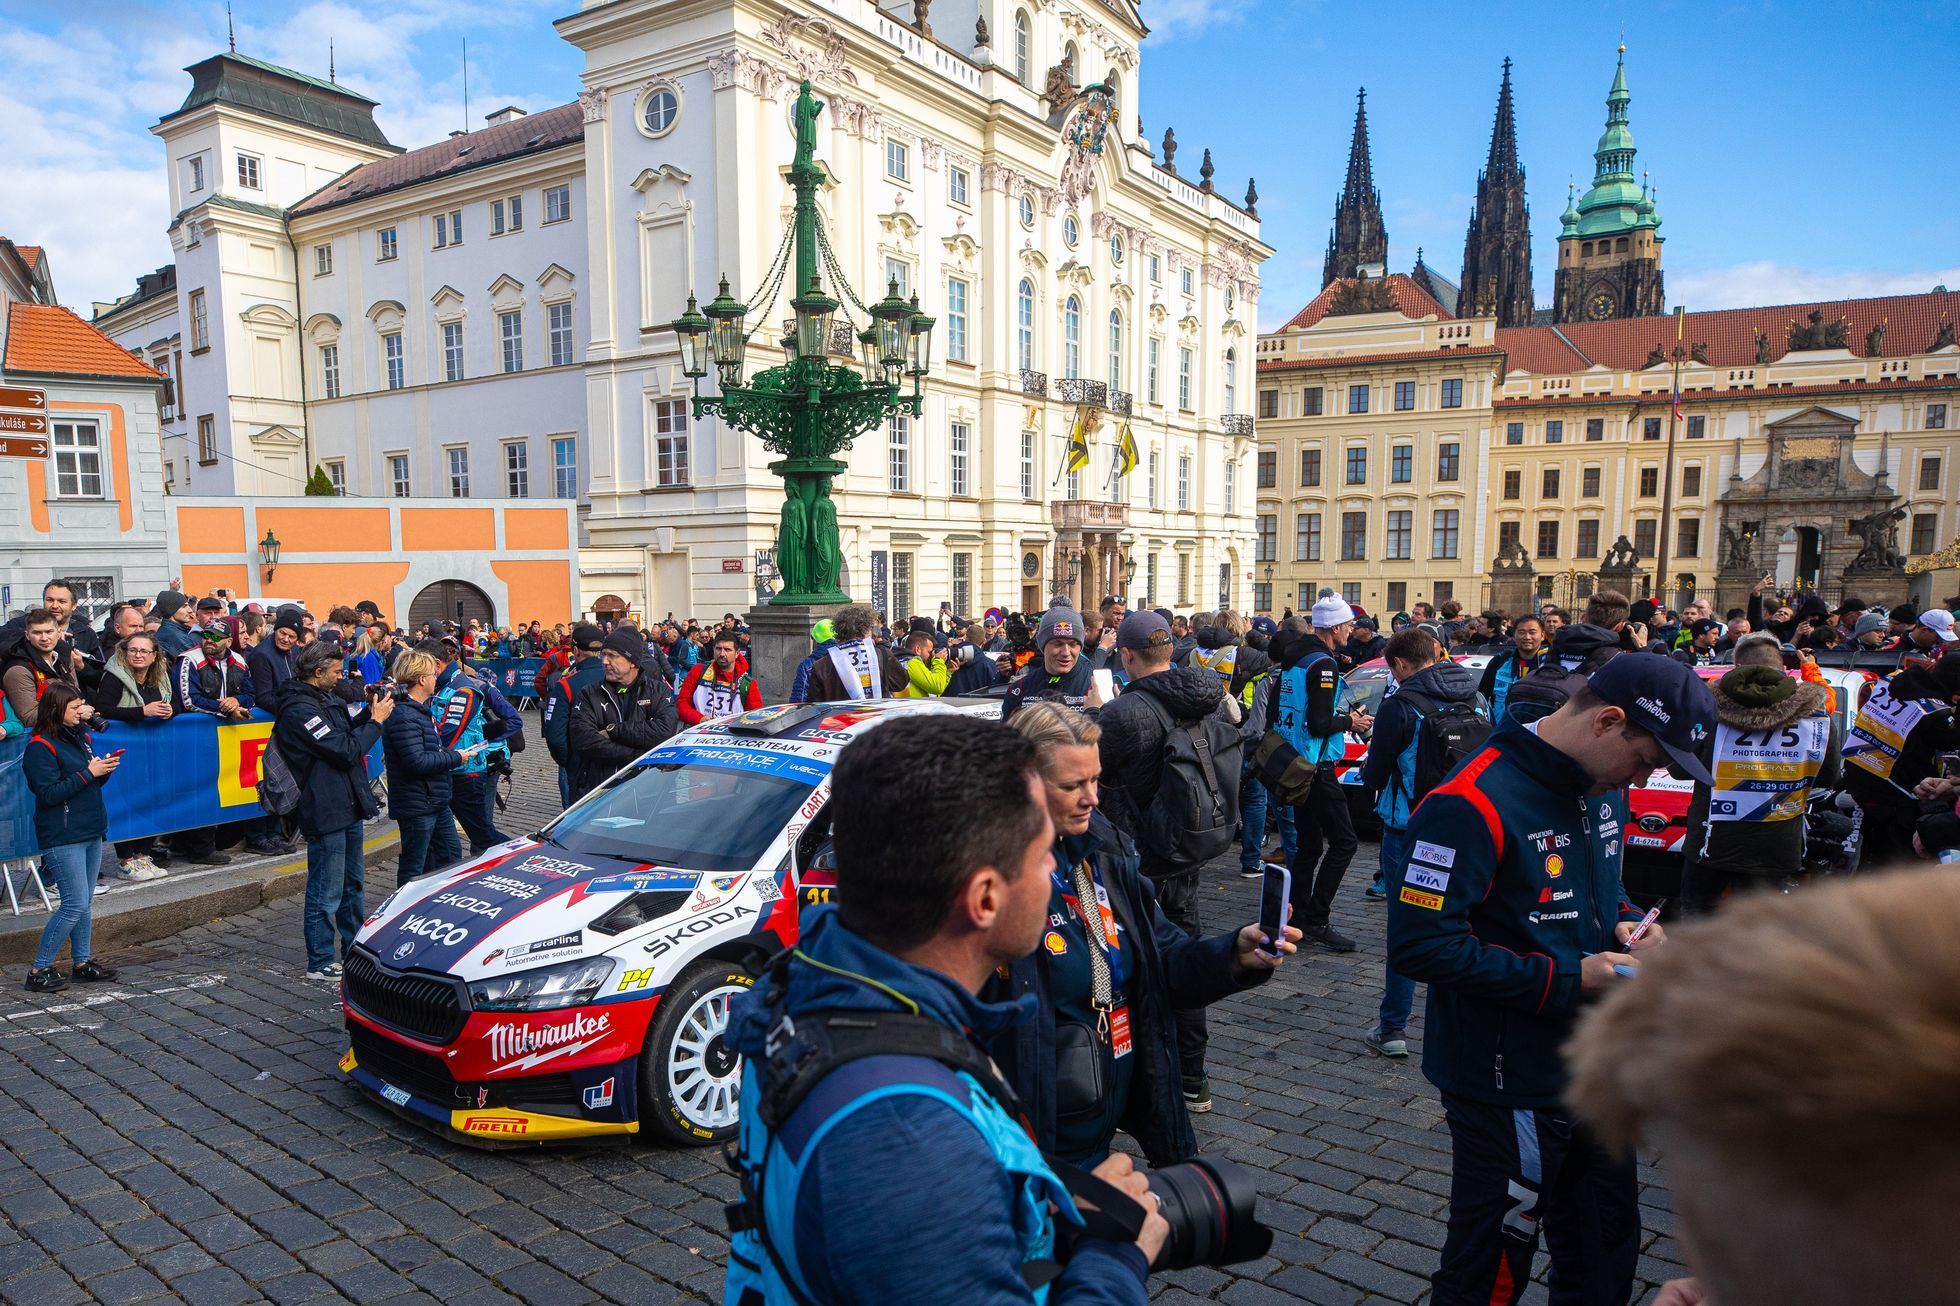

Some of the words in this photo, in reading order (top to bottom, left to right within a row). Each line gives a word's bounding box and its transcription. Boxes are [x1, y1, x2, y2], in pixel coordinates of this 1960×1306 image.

[0, 417, 26, 430] kuláše
[706, 692, 733, 712] 231
[1635, 696, 1671, 724] mikebon
[798, 728, 853, 742] LKQ
[692, 737, 731, 747] YACCO
[731, 738, 766, 751] ACCR
[768, 740, 803, 753] TEAM
[1732, 749, 1800, 758] PHOTOGRAPHER
[1779, 782, 1793, 790] OCT
[801, 790, 826, 820] GART
[1527, 829, 1554, 841] HYUNDAI
[1537, 833, 1571, 853] MOBIS
[1635, 837, 1660, 846] A-6764
[1420, 850, 1448, 864] MOBIS
[633, 880, 649, 890] 31
[1416, 874, 1440, 888] WIA
[484, 881, 535, 900] MOTOR
[1403, 891, 1440, 908] PIRELLI
[1540, 910, 1579, 921] RAUTIO
[398, 913, 471, 947] YACCO
[505, 953, 550, 968] Automotive
[552, 948, 583, 958] solution
[617, 966, 655, 992] P1
[726, 974, 756, 987] PZE
[482, 1012, 610, 1062] Milwaukee
[463, 1117, 529, 1134] PIRELLI
